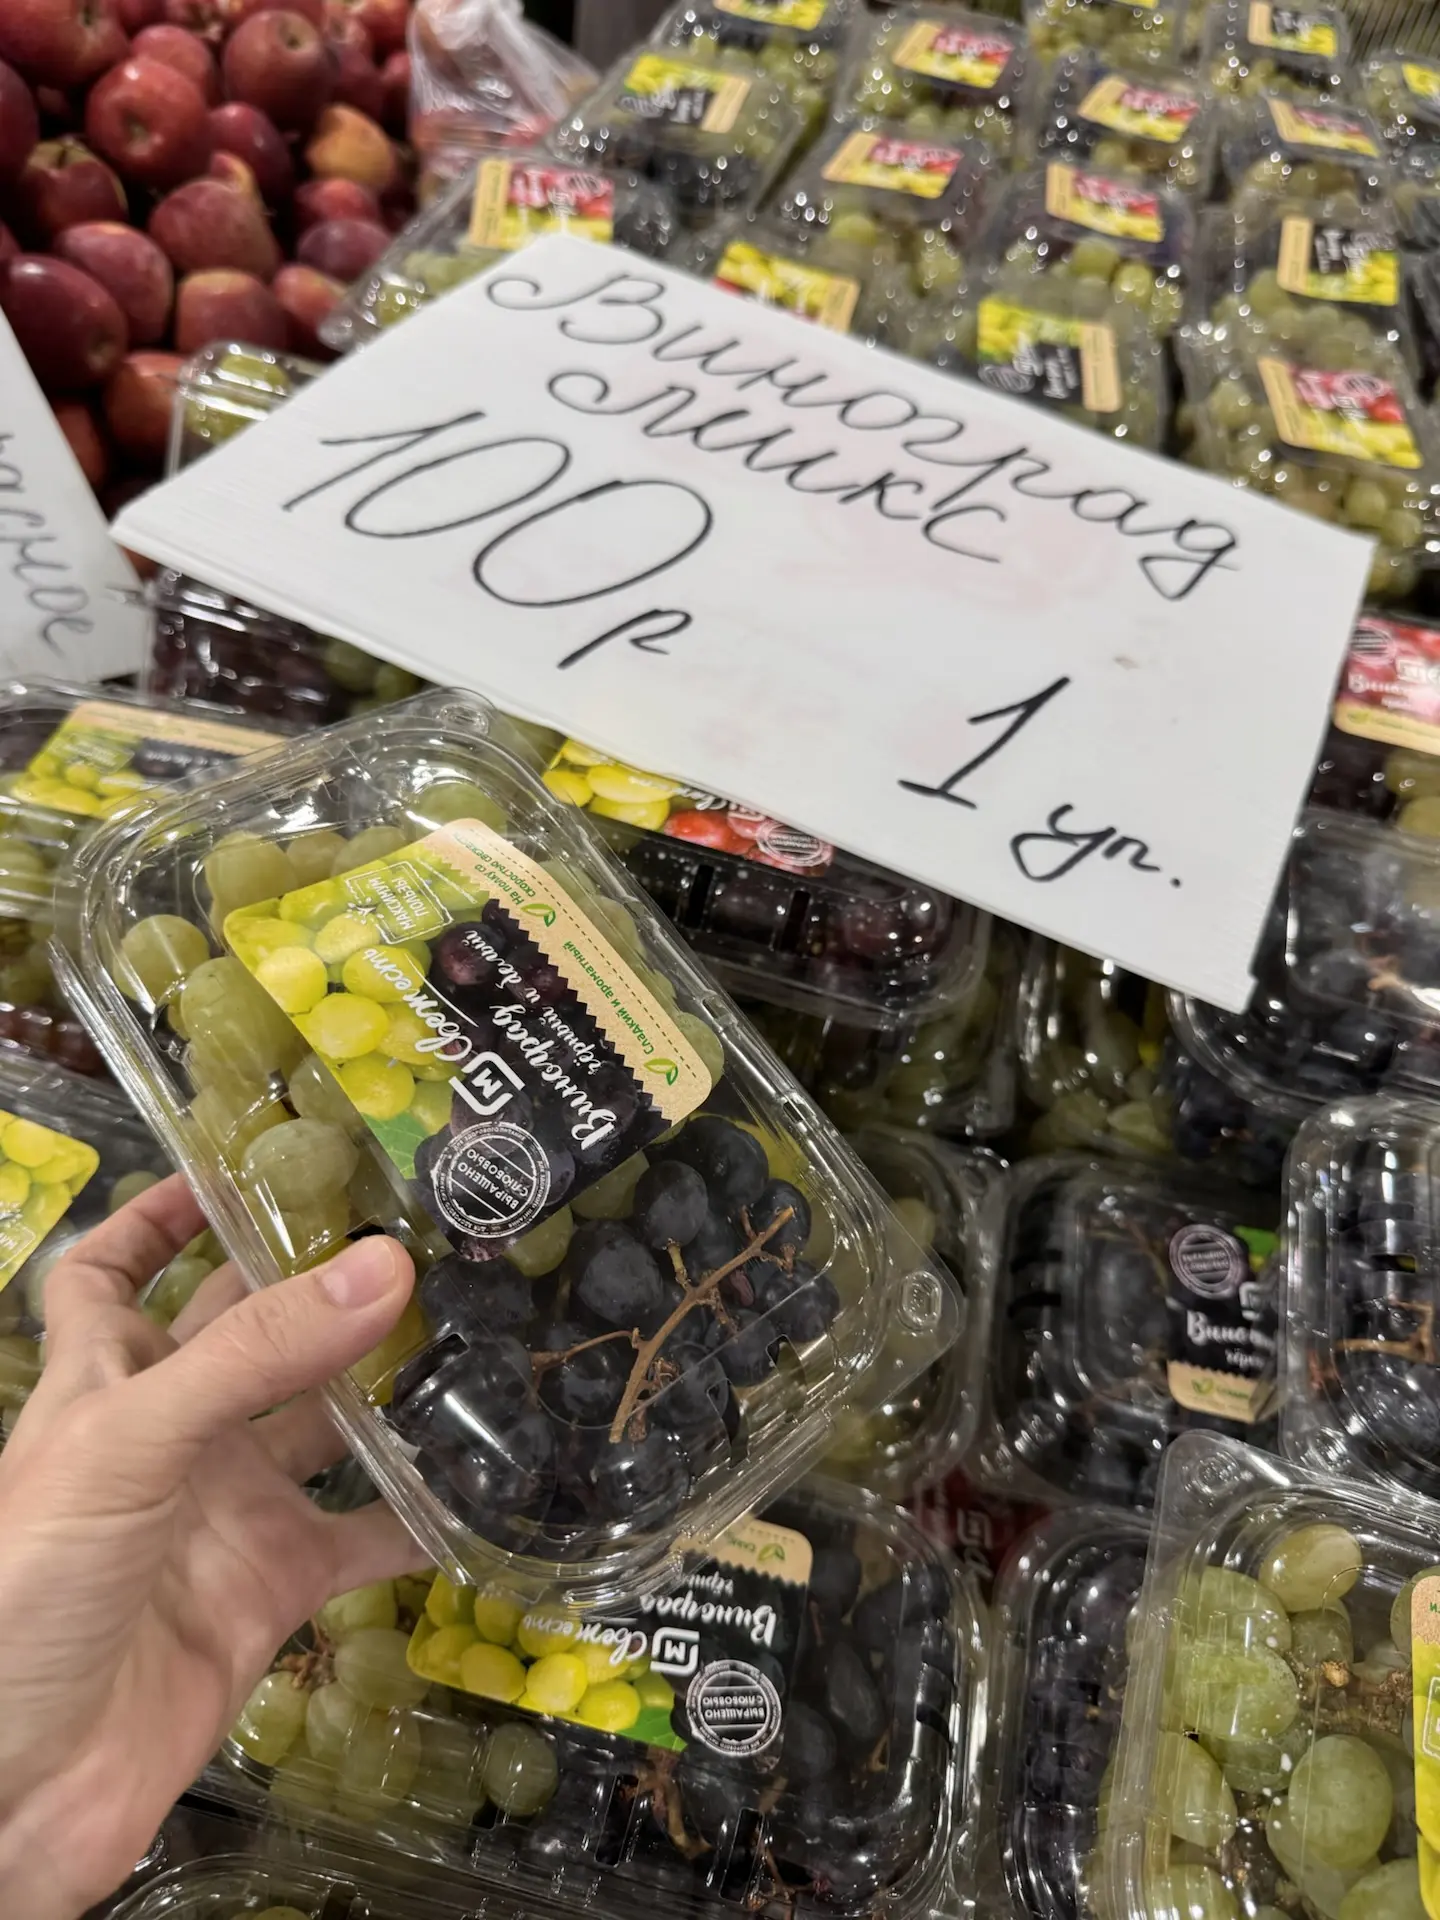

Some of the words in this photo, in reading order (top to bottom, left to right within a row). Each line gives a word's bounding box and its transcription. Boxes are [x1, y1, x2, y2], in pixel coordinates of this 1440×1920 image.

[486, 274, 1241, 601] Виноград
[897, 675, 1071, 810] 1
[1009, 803, 1181, 889] уп.
[474, 863, 487, 873] со
[483, 869, 512, 893] полку
[490, 860, 536, 898] скоростью
[368, 876, 416, 931] МАКСИМУМ
[391, 876, 430, 917] ПОЛЬЗЫ
[510, 889, 525, 905] На
[461, 929, 523, 990] белый
[562, 940, 615, 999] ароматный
[362, 947, 473, 1062] Свежесть
[524, 986, 542, 1004] и
[610, 998, 622, 1009] и
[540, 1005, 605, 1076] чёрный
[615, 1007, 655, 1056] Сладкий
[488, 1003, 618, 1150] Виноград
[457, 1161, 520, 1210] ВЫРАЩЕНО
[522, 1614, 648, 1666] Свежесть
[702, 1695, 756, 1707] ЛЮБОВЬЮ
[704, 1707, 766, 1720] ВЫРАЩЕНО
